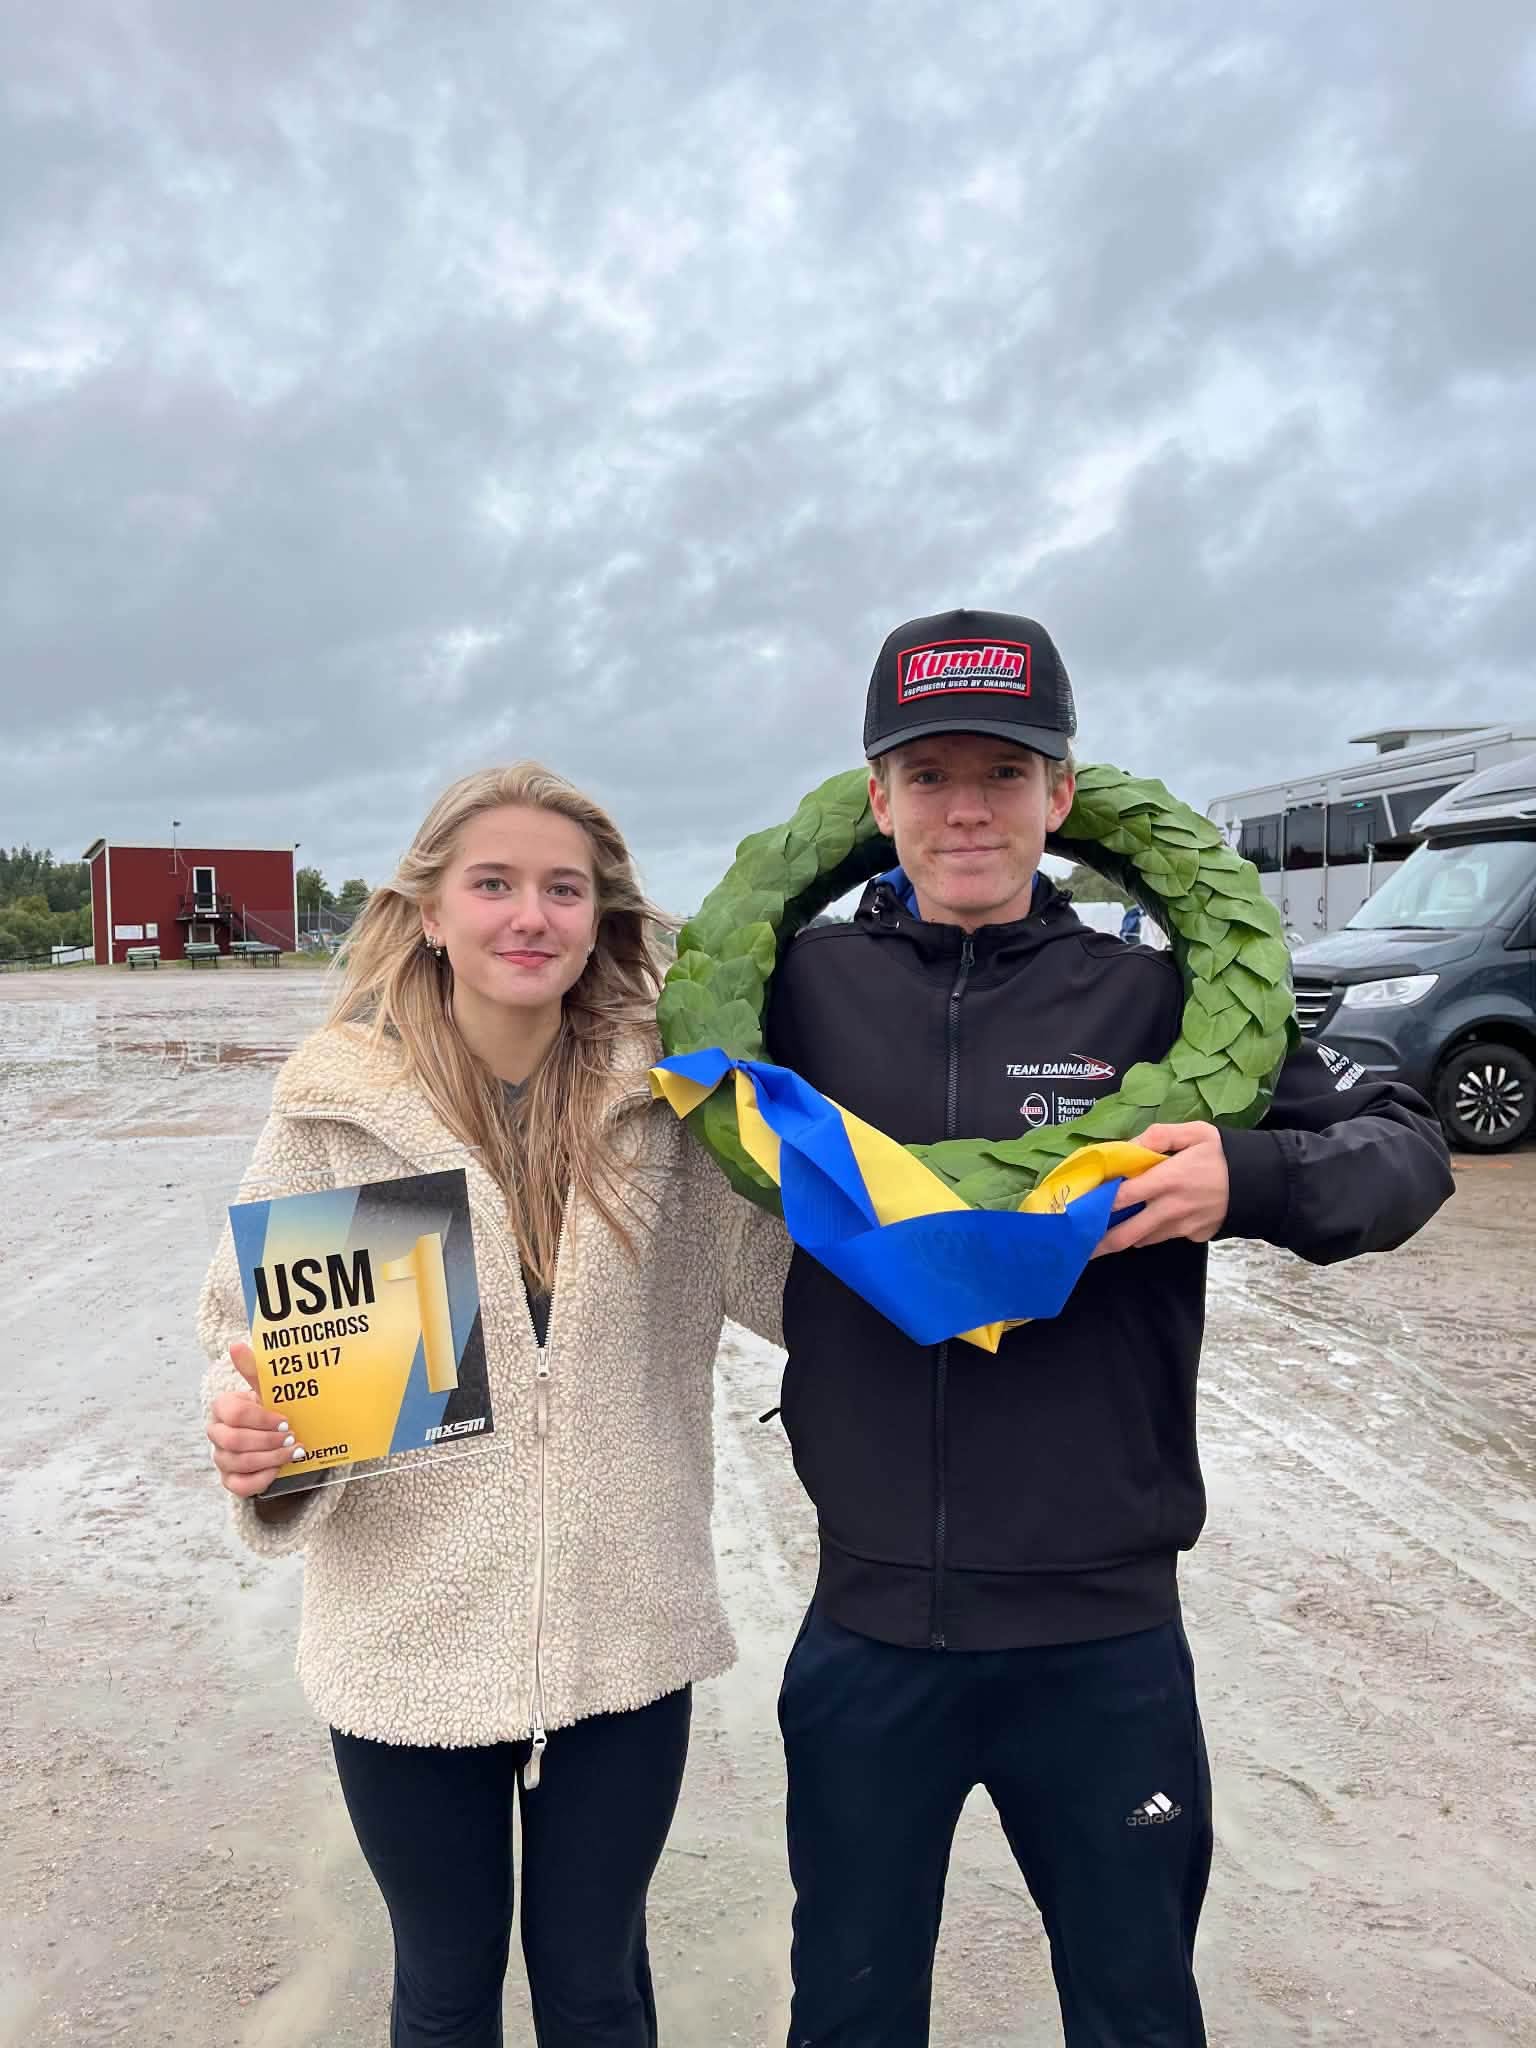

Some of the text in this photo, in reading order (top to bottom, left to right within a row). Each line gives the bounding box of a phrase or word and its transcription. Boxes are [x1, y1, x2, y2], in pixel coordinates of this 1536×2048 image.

[905, 647, 1024, 684] Kumlin
[942, 665, 1014, 677] Suspension
[948, 680, 968, 688] USED
[970, 679, 982, 687] BY
[1006, 1063, 1099, 1075] TEAM DANMARK
[1057, 1106, 1085, 1115] Motor
[254, 1249, 375, 1322] USM
[382, 1232, 459, 1394] 1
[262, 1314, 369, 1350] MOTOCROSS
[268, 1346, 341, 1377] 125 U17
[272, 1378, 319, 1404] 2026
[1126, 1805, 1182, 1826] adidas
